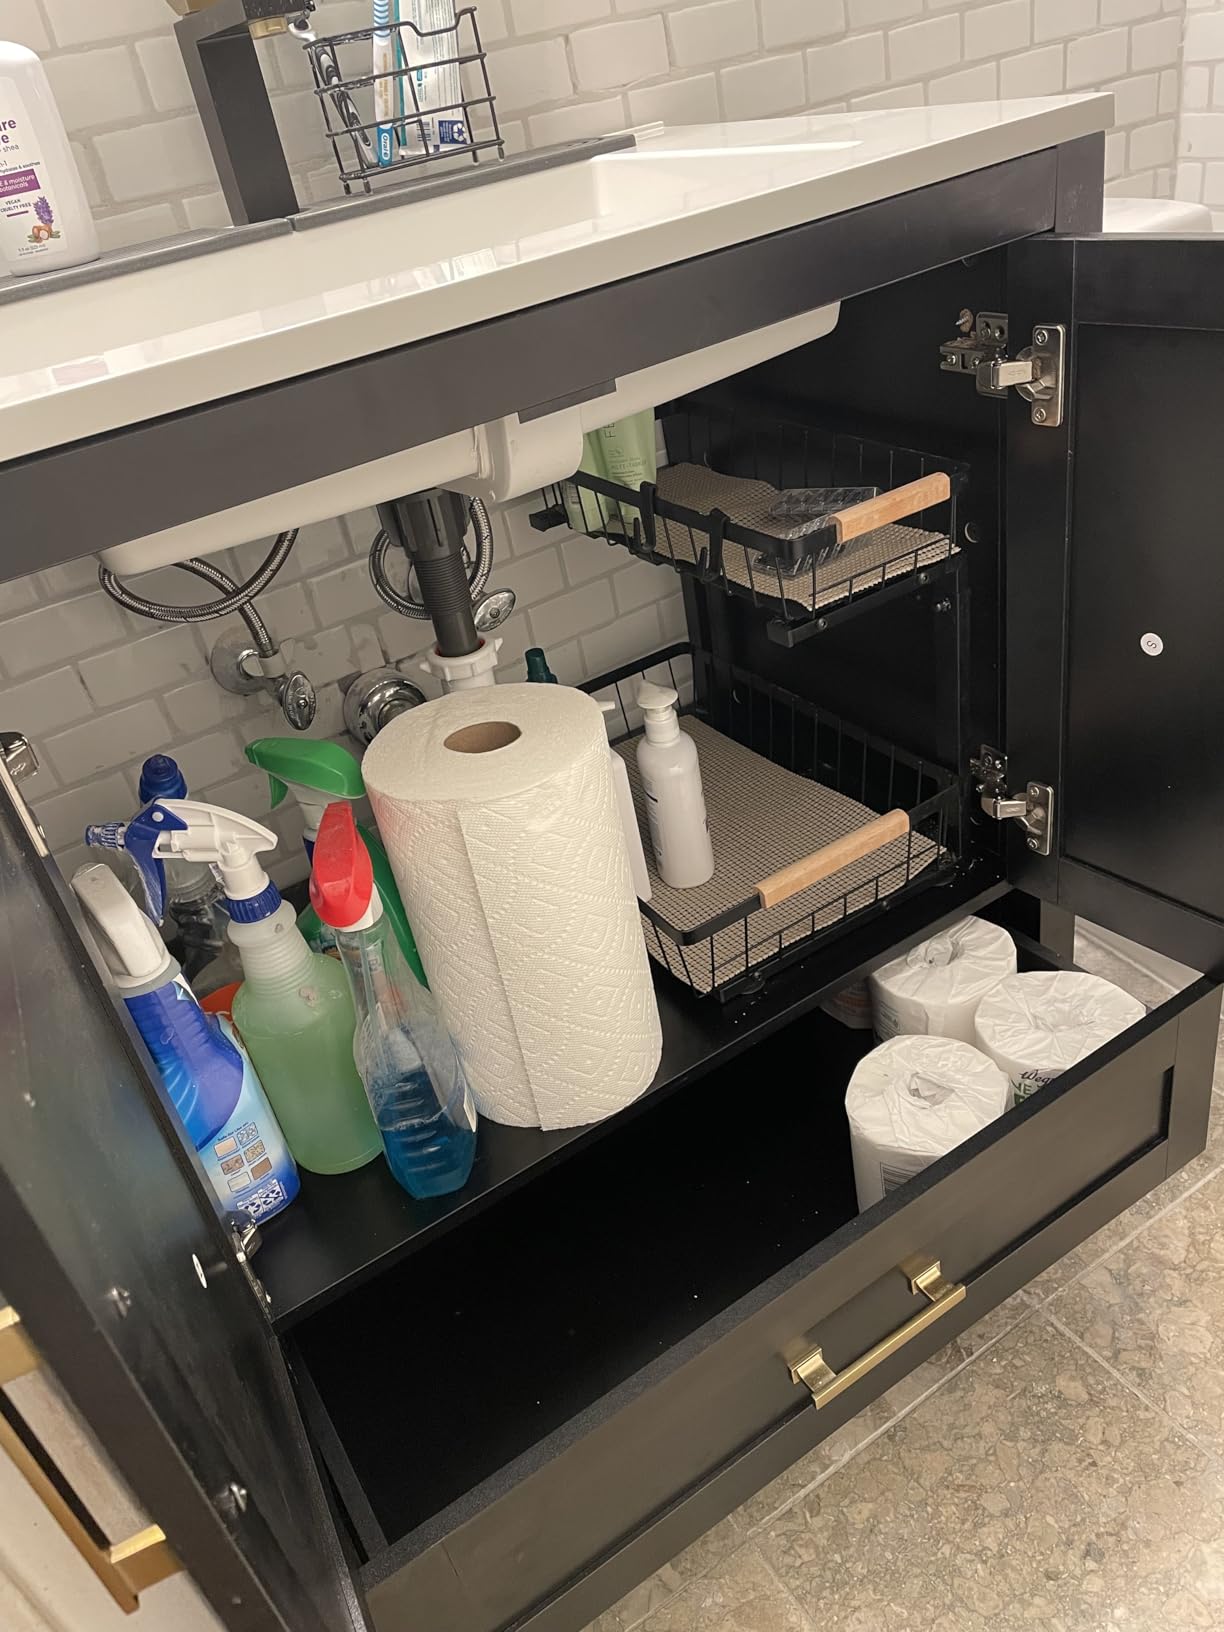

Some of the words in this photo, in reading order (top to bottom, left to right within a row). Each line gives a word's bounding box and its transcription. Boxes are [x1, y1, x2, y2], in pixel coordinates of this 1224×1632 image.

[2, 144, 20, 152] shea
[8, 174, 36, 185] moisture
[0, 204, 20, 213] CRUELTY
[1146, 640, 1157, 649] S
[1018, 1069, 1055, 1087] Weg
